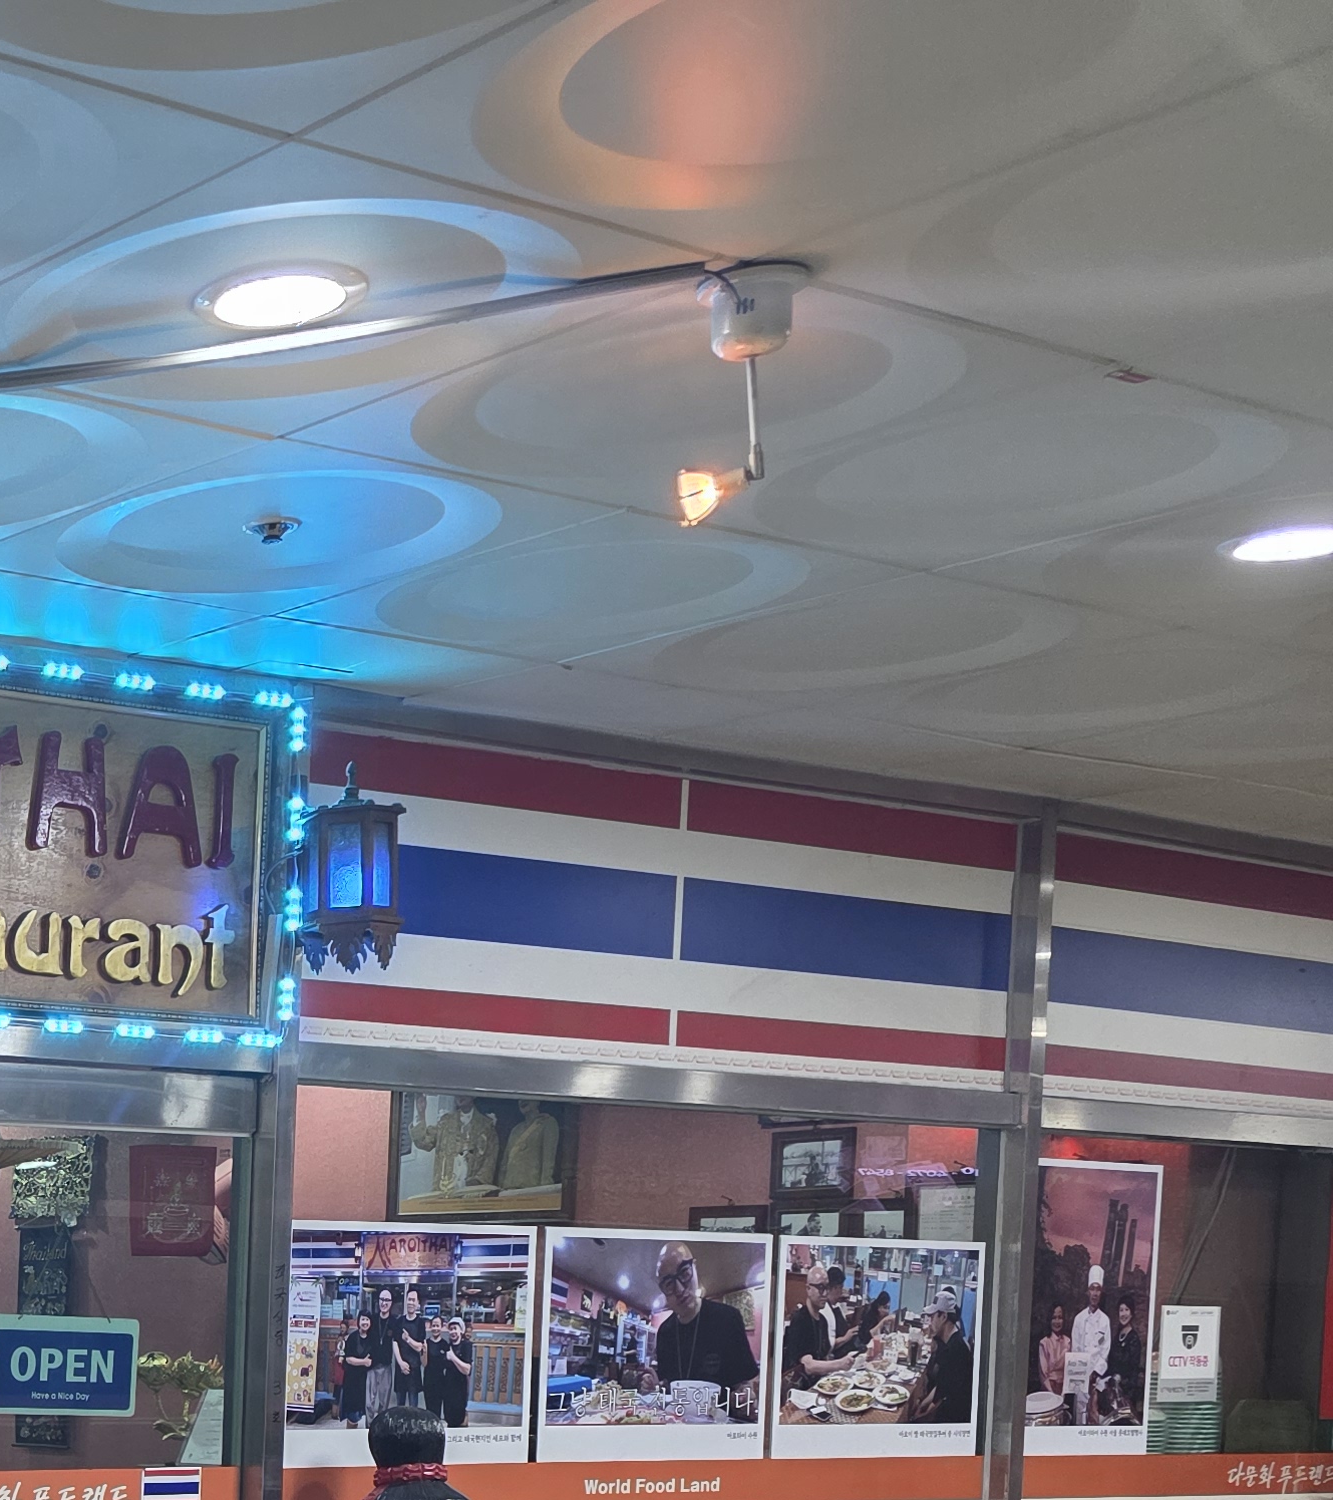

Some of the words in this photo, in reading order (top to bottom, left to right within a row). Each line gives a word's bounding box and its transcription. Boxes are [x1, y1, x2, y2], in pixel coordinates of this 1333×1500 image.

[10, 1345, 115, 1384] OPEN
[1168, 1356, 1188, 1367] CCTV
[32, 1391, 50, 1400] Have
[58, 1392, 74, 1400] Nice
[76, 1392, 90, 1401] Day
[546, 1387, 591, 1418] 그냥
[599, 1387, 642, 1417] 태국
[585, 1479, 631, 1495] World
[636, 1478, 676, 1494] Food
[680, 1477, 721, 1493] Land
[1227, 1461, 1275, 1489] 다문화
